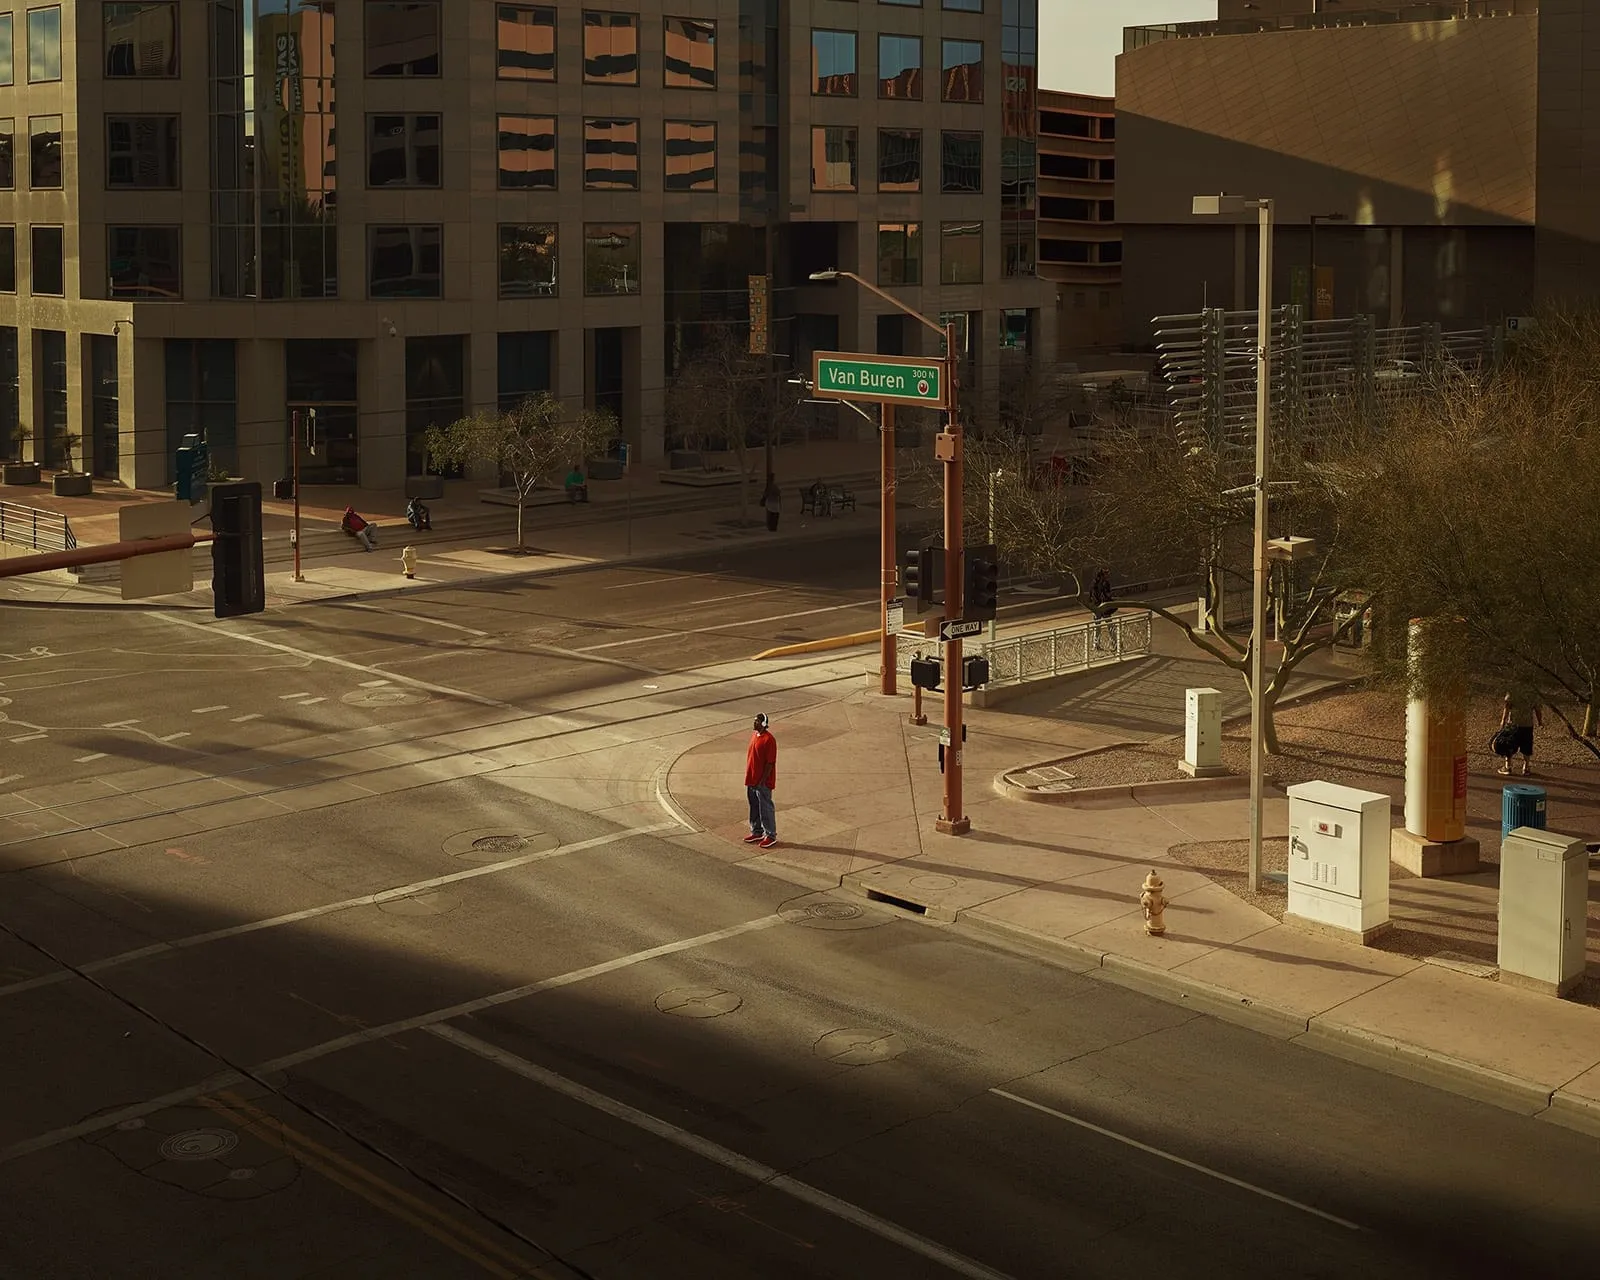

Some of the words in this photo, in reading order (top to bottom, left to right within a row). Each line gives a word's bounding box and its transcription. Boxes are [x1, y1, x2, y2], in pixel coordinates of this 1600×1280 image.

[829, 368, 855, 385] Van
[860, 370, 904, 389] Buren
[912, 370, 926, 378] 300
[928, 371, 934, 379] N
[952, 624, 964, 634] ONE
[965, 622, 978, 632] WAY
